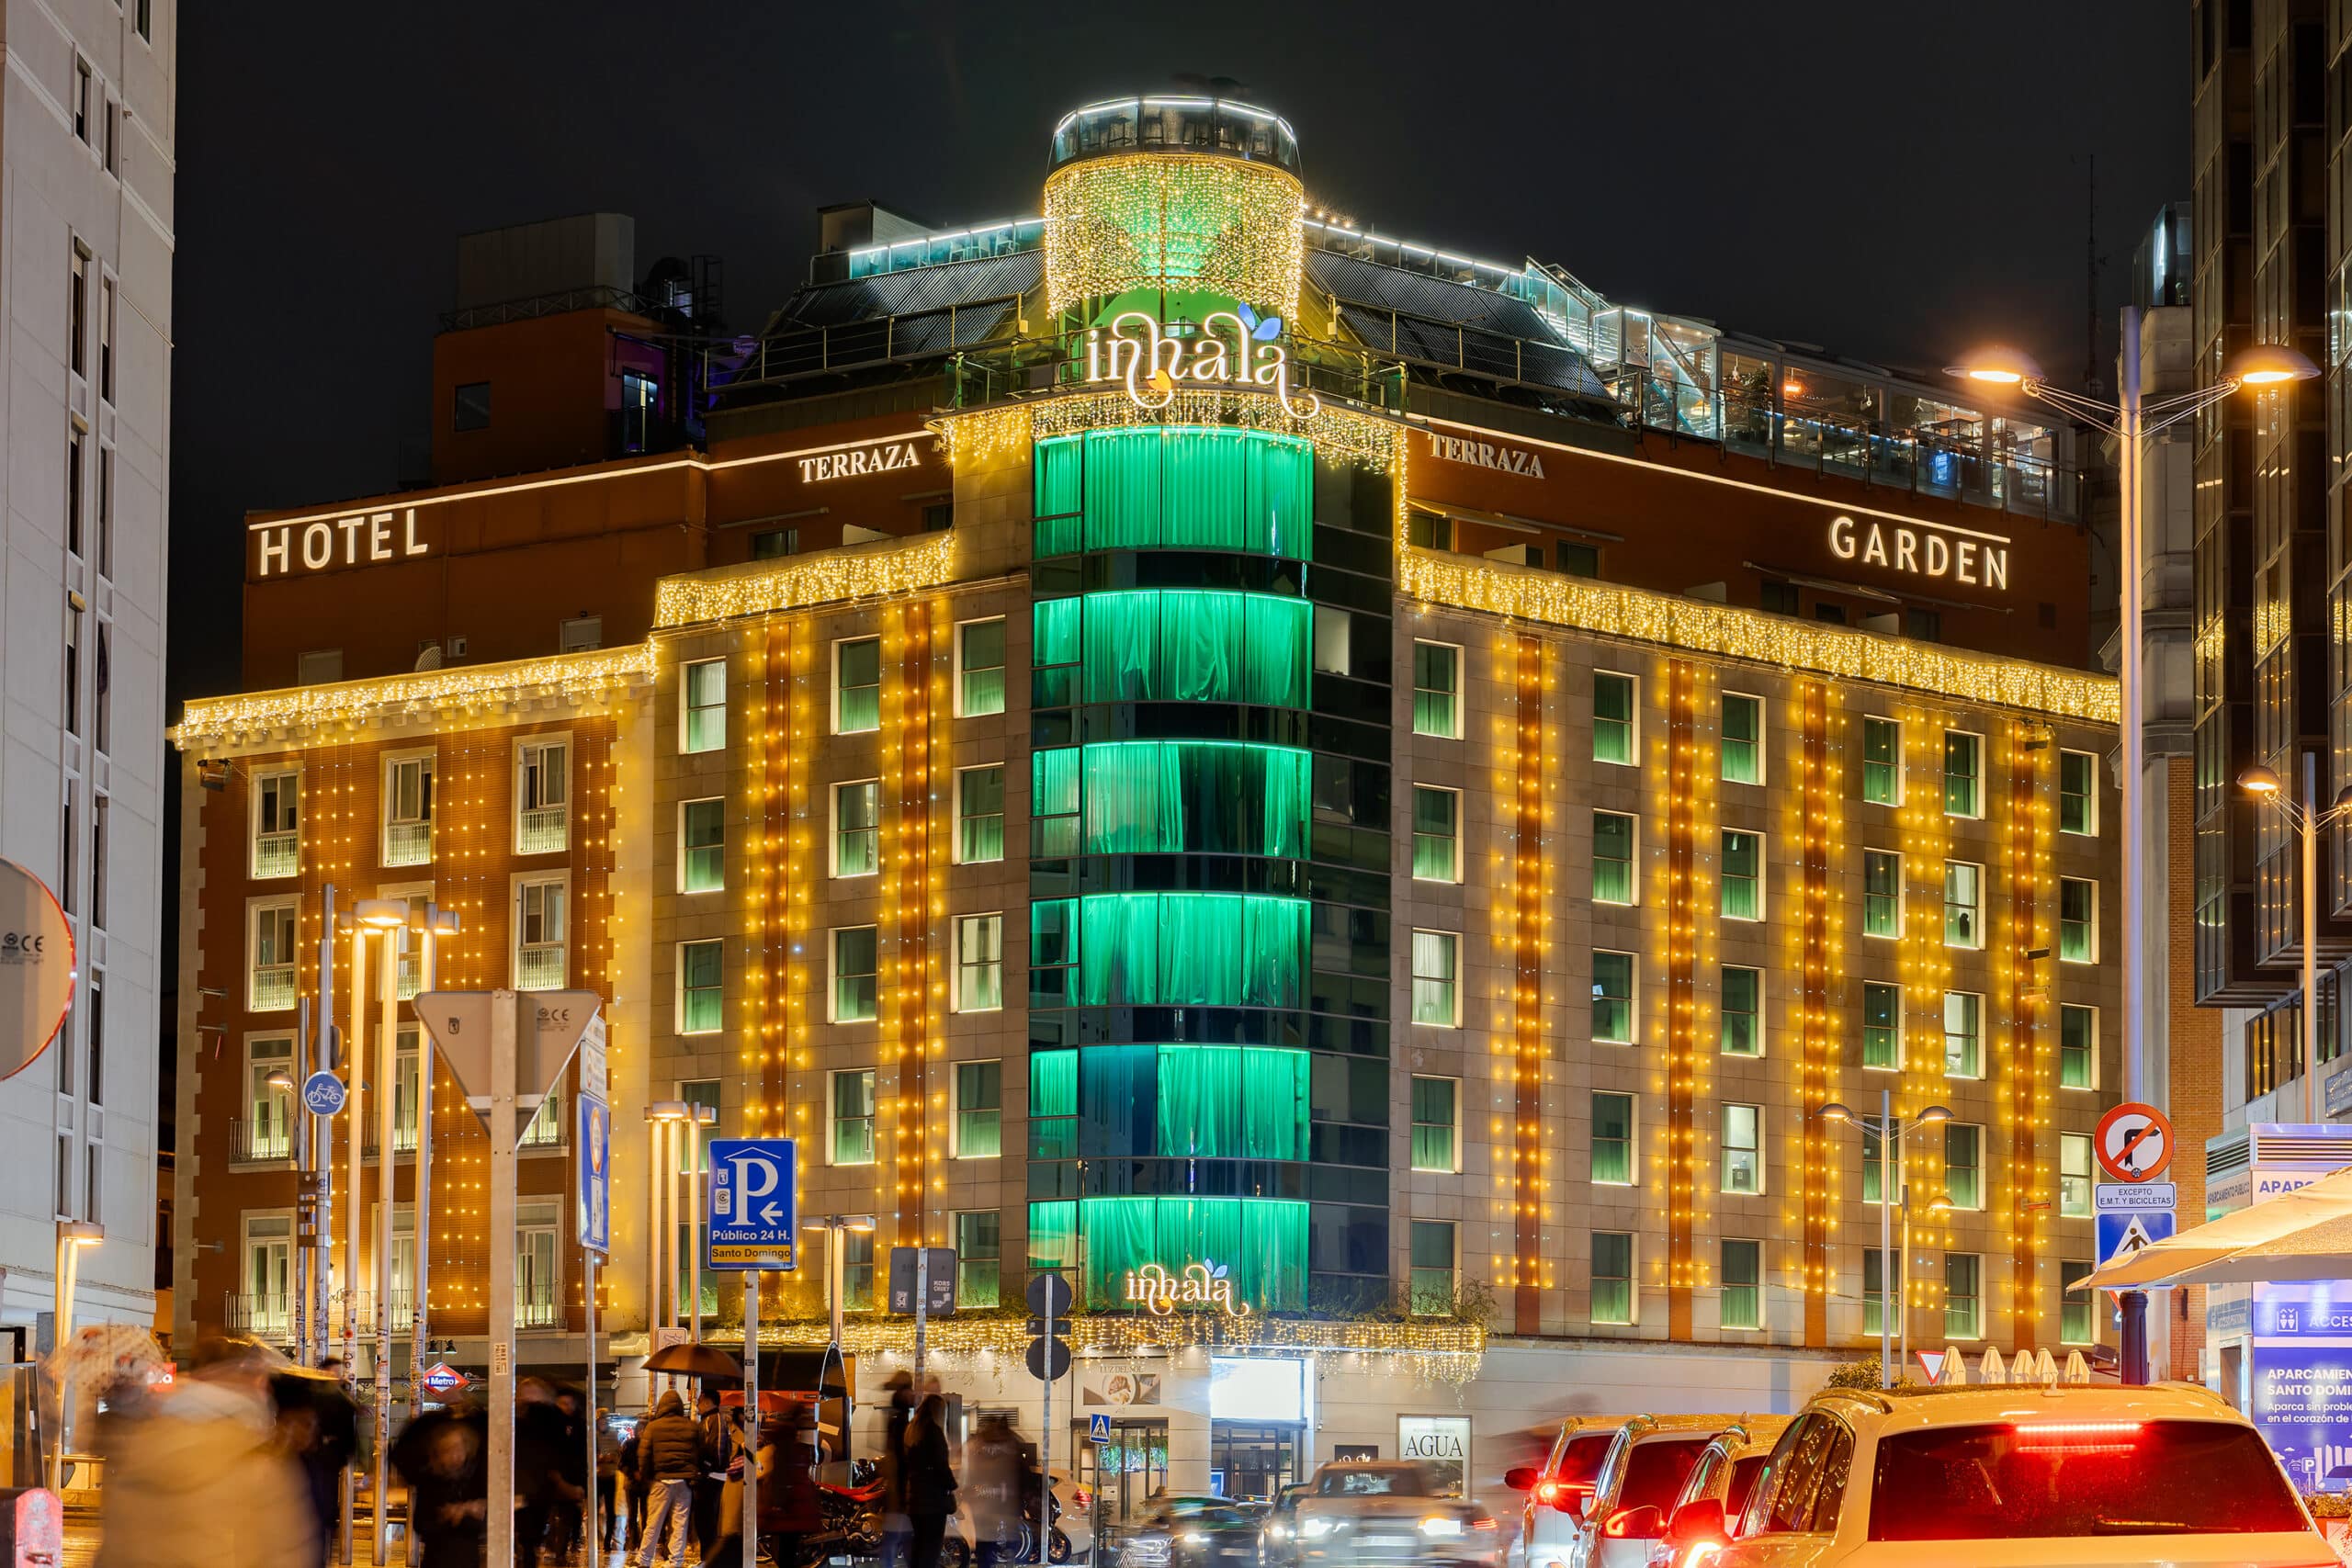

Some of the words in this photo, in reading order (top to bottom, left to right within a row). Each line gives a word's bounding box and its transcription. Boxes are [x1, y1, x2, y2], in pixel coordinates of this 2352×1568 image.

[1085, 312, 1319, 419] inhala
[798, 442, 919, 483] TERRAZA
[1428, 431, 1545, 479] TERRAZA
[259, 508, 428, 576] HOTEL
[1828, 515, 2008, 591] GARDEN
[728, 1158, 778, 1225] P
[2118, 1188, 2153, 1196] EXCEPTO
[2129, 1197, 2171, 1205] BICICLETAS
[712, 1230, 757, 1240] Público
[760, 1230, 775, 1240] 24
[777, 1231, 790, 1240] H.
[712, 1248, 741, 1258] Santo
[744, 1248, 791, 1259] Domingo
[1126, 1264, 1250, 1317] inhala
[430, 1377, 455, 1387] Metro
[2267, 1384, 2312, 1395] SANTO
[2267, 1403, 2304, 1413] Aparca
[2306, 1402, 2321, 1411] sin
[2282, 1414, 2291, 1423] el
[2293, 1414, 2334, 1423] corazón
[2335, 1414, 2349, 1423] de
[1405, 1436, 1463, 1457] AGUA
